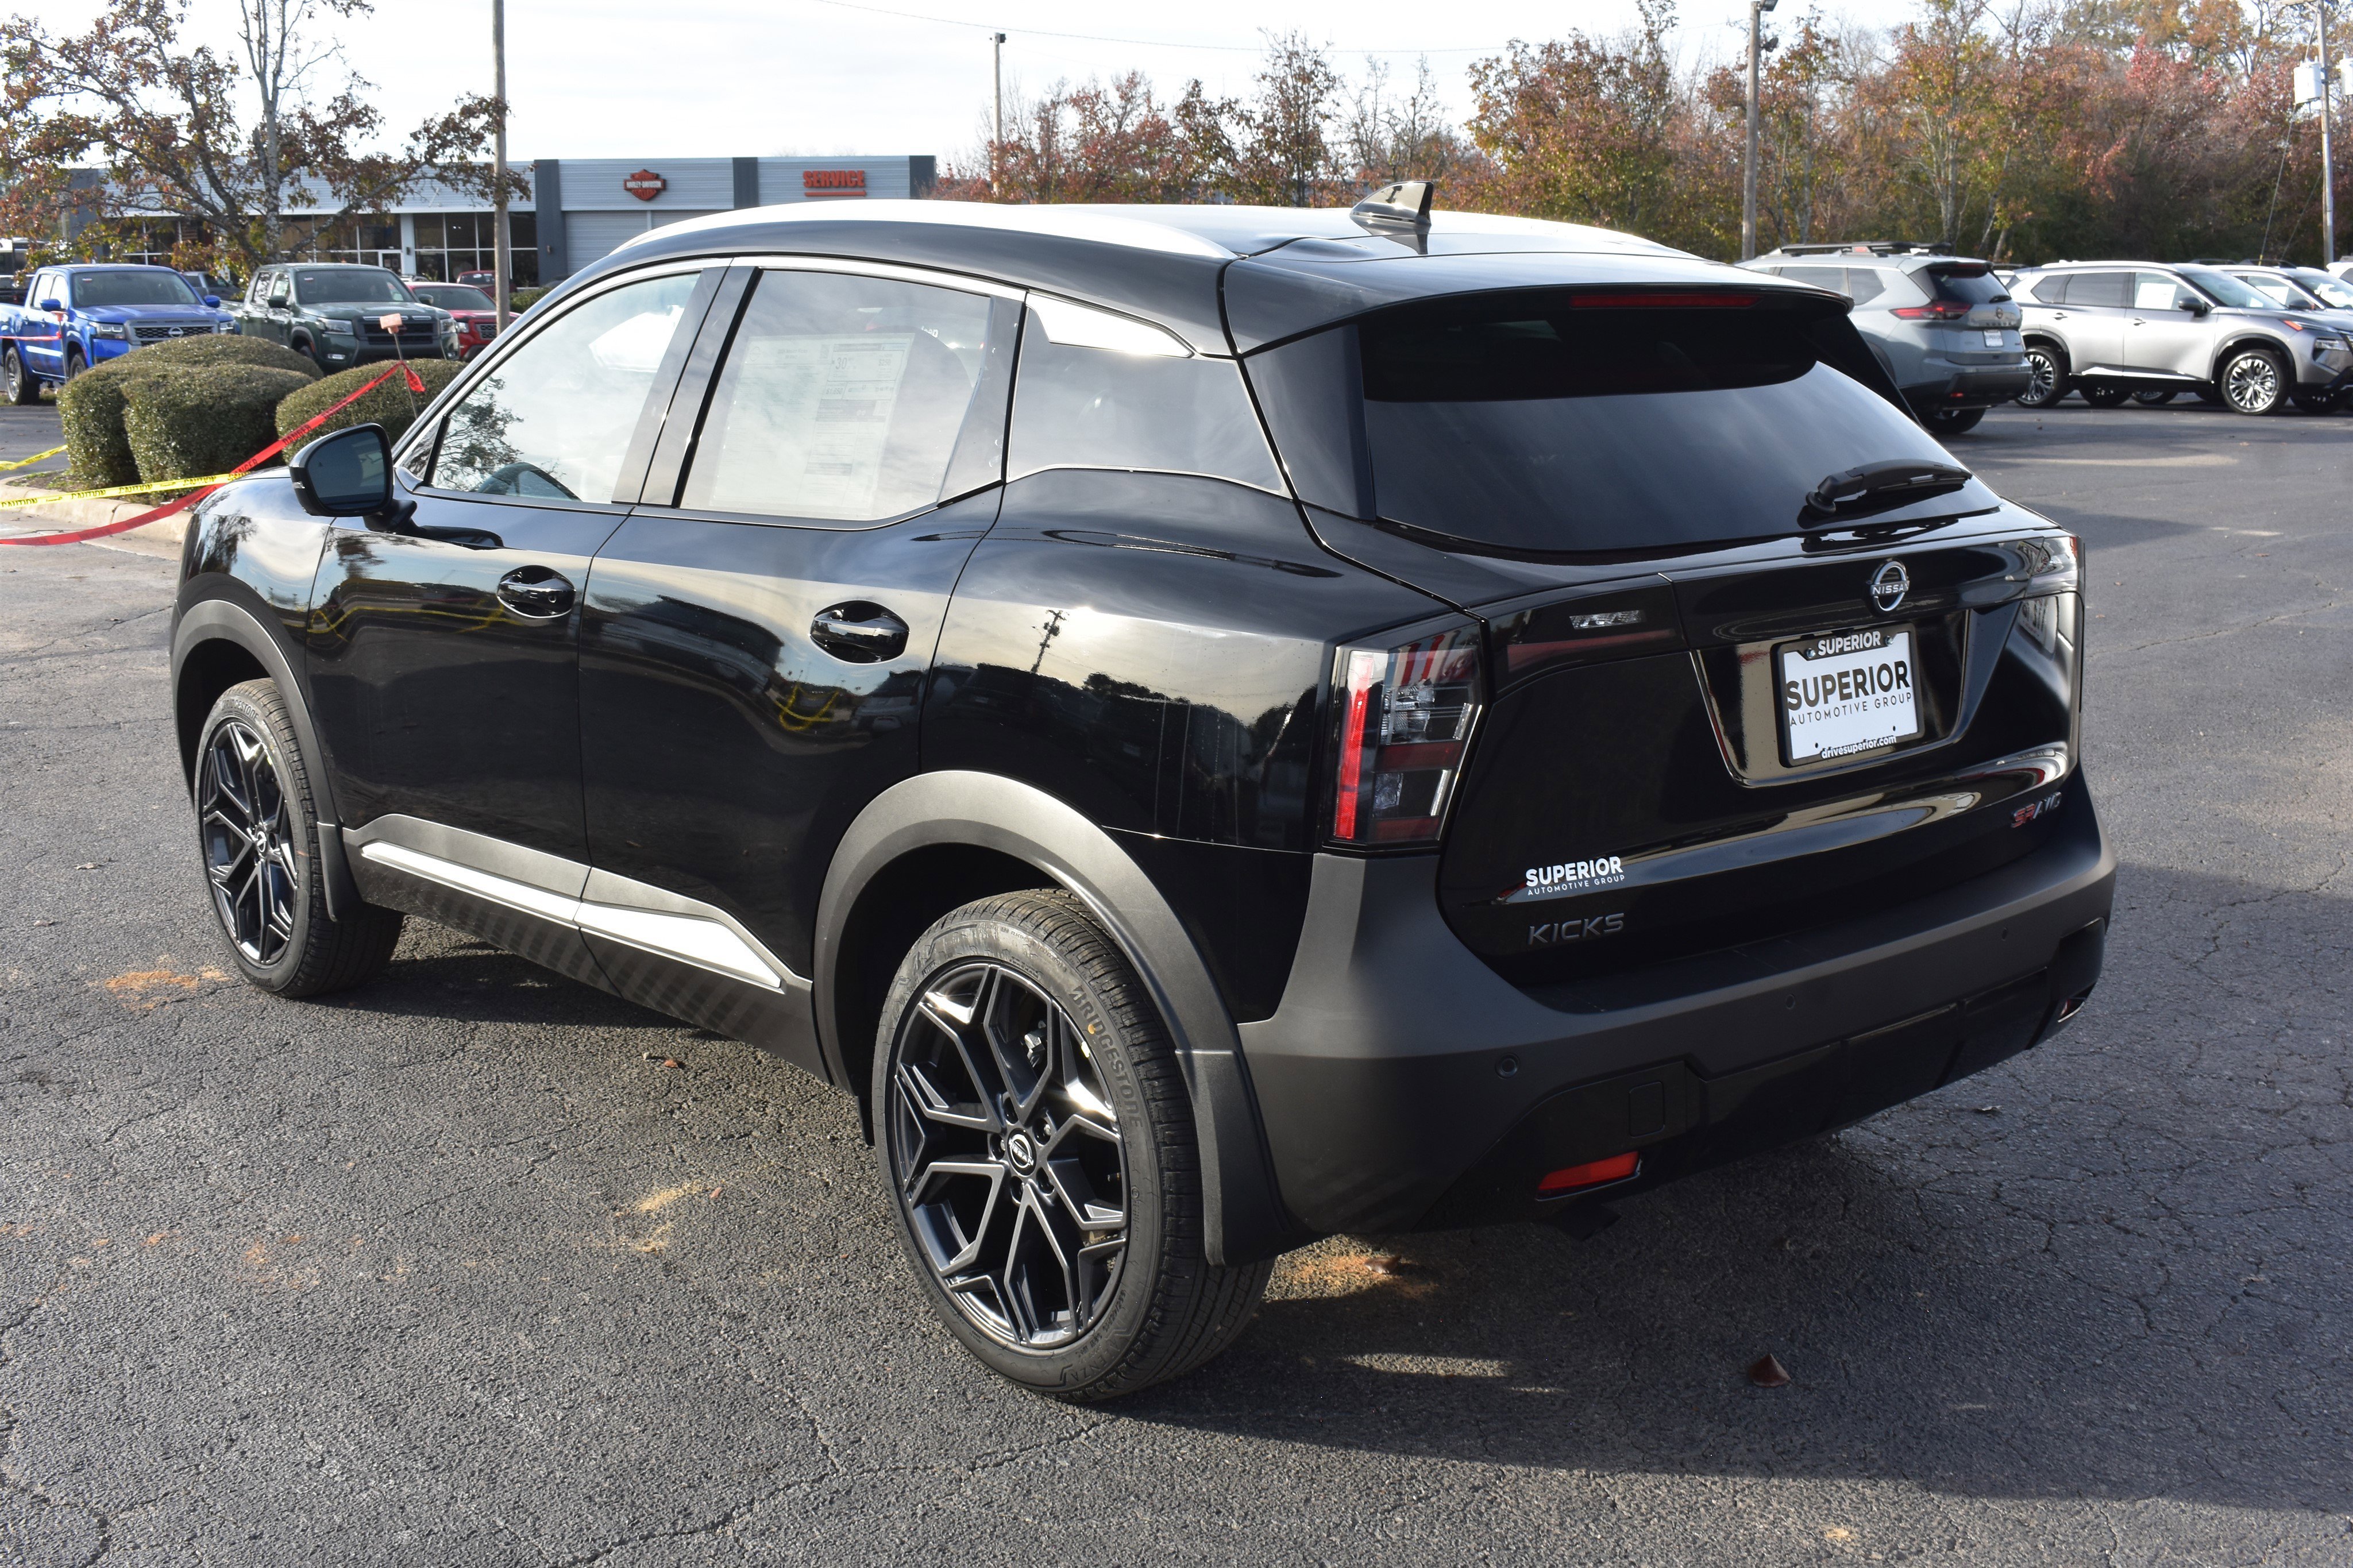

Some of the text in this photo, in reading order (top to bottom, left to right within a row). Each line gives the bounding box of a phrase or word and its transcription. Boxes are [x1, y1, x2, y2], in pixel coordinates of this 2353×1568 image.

[803, 170, 865, 188] SERVICE
[835, 357, 848, 370] 30
[281, 423, 313, 445] DANGER
[1872, 581, 1910, 596] NISSAN
[1818, 631, 1881, 656] SUPERIOR
[1787, 660, 1911, 711] SUPERIOR
[1789, 692, 1912, 727] AUTOMOTIVE GROUP
[1820, 735, 1897, 759] drivesuperior.com
[1525, 856, 1624, 887] SUPERIOR
[1527, 875, 1626, 896] AUTOMOTIVE GROUP
[1526, 912, 1625, 945] KICKS
[1069, 984, 1144, 1129] BRIDGESTONE
